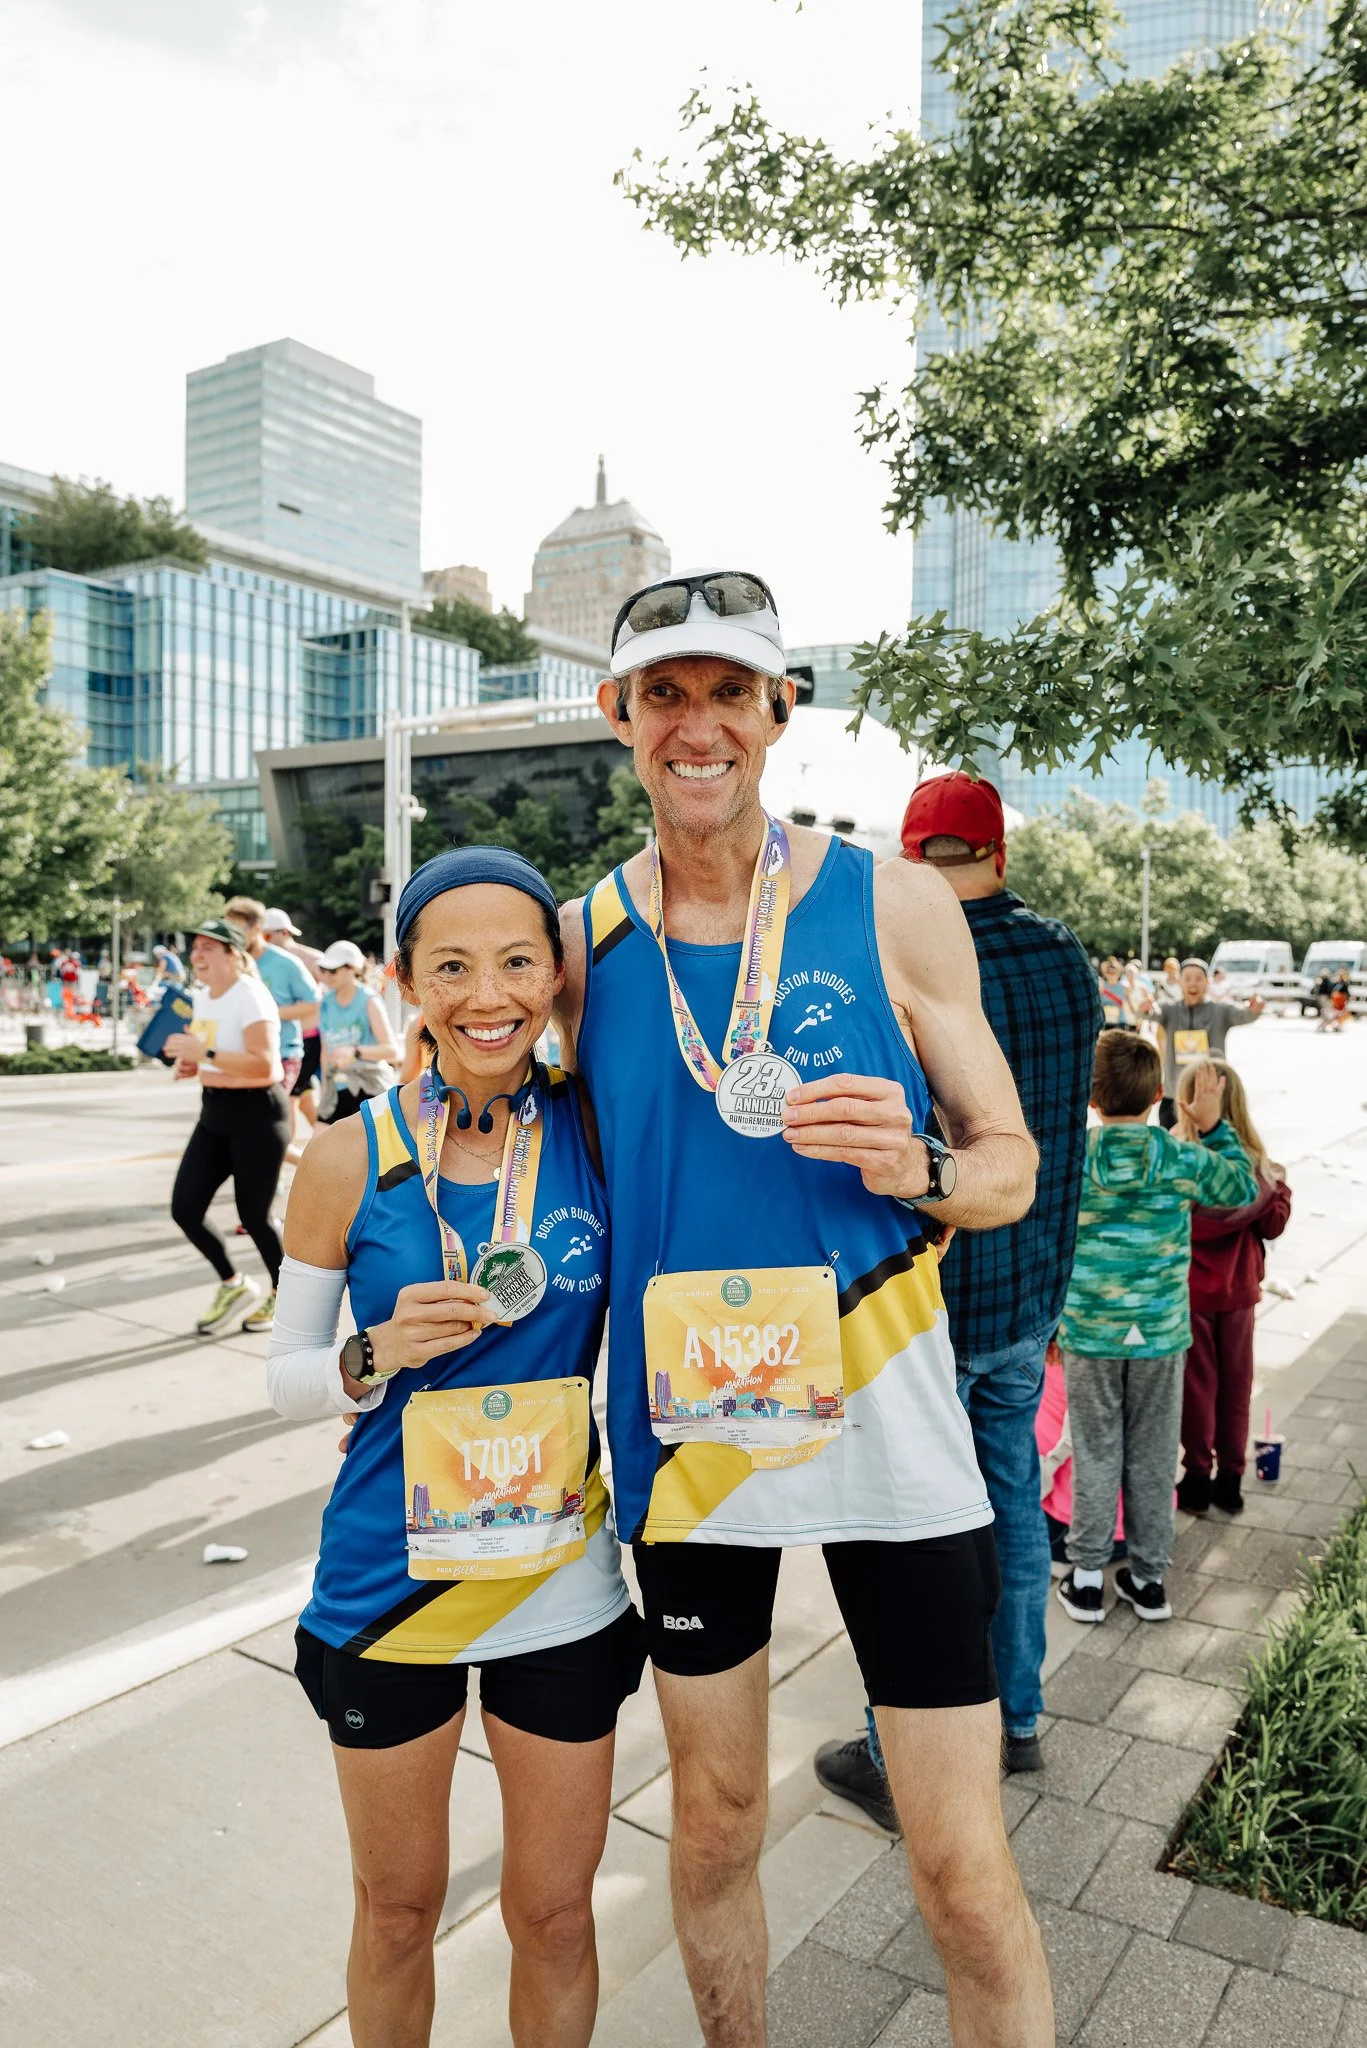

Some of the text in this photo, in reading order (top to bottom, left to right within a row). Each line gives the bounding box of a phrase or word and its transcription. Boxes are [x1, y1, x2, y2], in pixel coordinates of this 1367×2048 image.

[747, 880, 772, 986] MEMORIAL MARATHON
[812, 970, 856, 1005] BUDDIES
[784, 1046, 843, 1068] RUN CLUB
[734, 1097, 782, 1116] ANNUAL
[504, 1127, 527, 1228] MEMORIAL MARATHON
[536, 1206, 605, 1240] BOSTON BUDDIES
[496, 1272, 531, 1302] MEMORIAL
[501, 1279, 536, 1310] MARATHON
[552, 1274, 602, 1292] RUN CLUB
[684, 1323, 800, 1368] A15382
[723, 1374, 763, 1391] MARATHON
[459, 1434, 542, 1480] 17031
[483, 1484, 521, 1500] MARATHON
[527, 1490, 556, 1499] REMEMBER
[452, 1562, 480, 1577] BEER!
